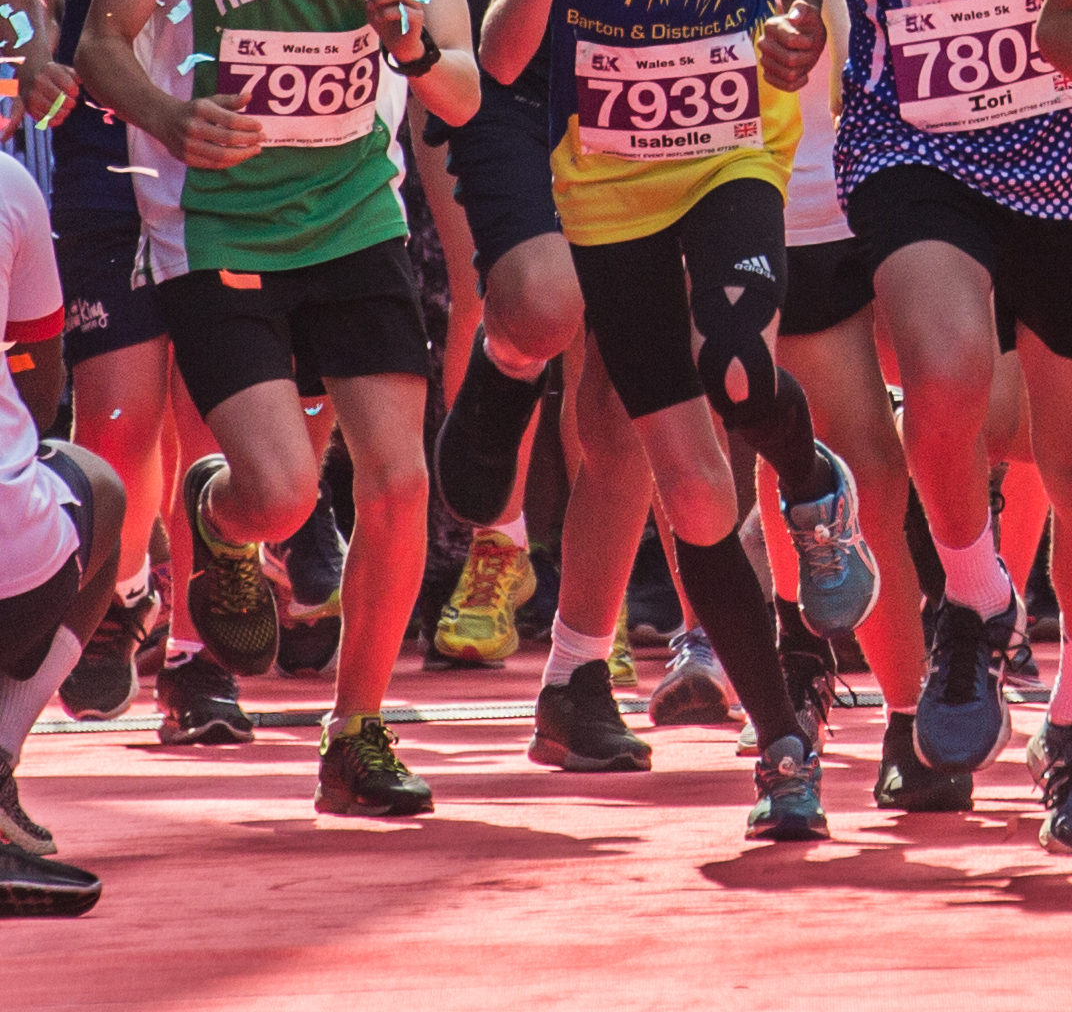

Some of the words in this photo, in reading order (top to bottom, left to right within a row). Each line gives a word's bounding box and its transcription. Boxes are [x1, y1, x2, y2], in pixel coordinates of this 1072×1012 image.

[566, 8, 625, 38] Barton
[631, 25, 645, 39] &
[652, 22, 721, 39] District
[905, 13, 936, 33] 5K
[950, 10, 990, 23] Wales
[995, 5, 1010, 16] 5k
[238, 39, 267, 56] 5K
[282, 44, 320, 54] Wales
[324, 44, 339, 54] 5k
[352, 32, 370, 55] 5K
[591, 53, 621, 72] 5K
[636, 59, 675, 70] Wales
[680, 56, 695, 66] 5k
[710, 44, 739, 65] 5K
[903, 22, 1058, 98] 7805
[230, 57, 373, 115] 7968
[588, 71, 749, 130] 7939
[968, 90, 1013, 113] Iori
[630, 131, 711, 148] Isabelle
